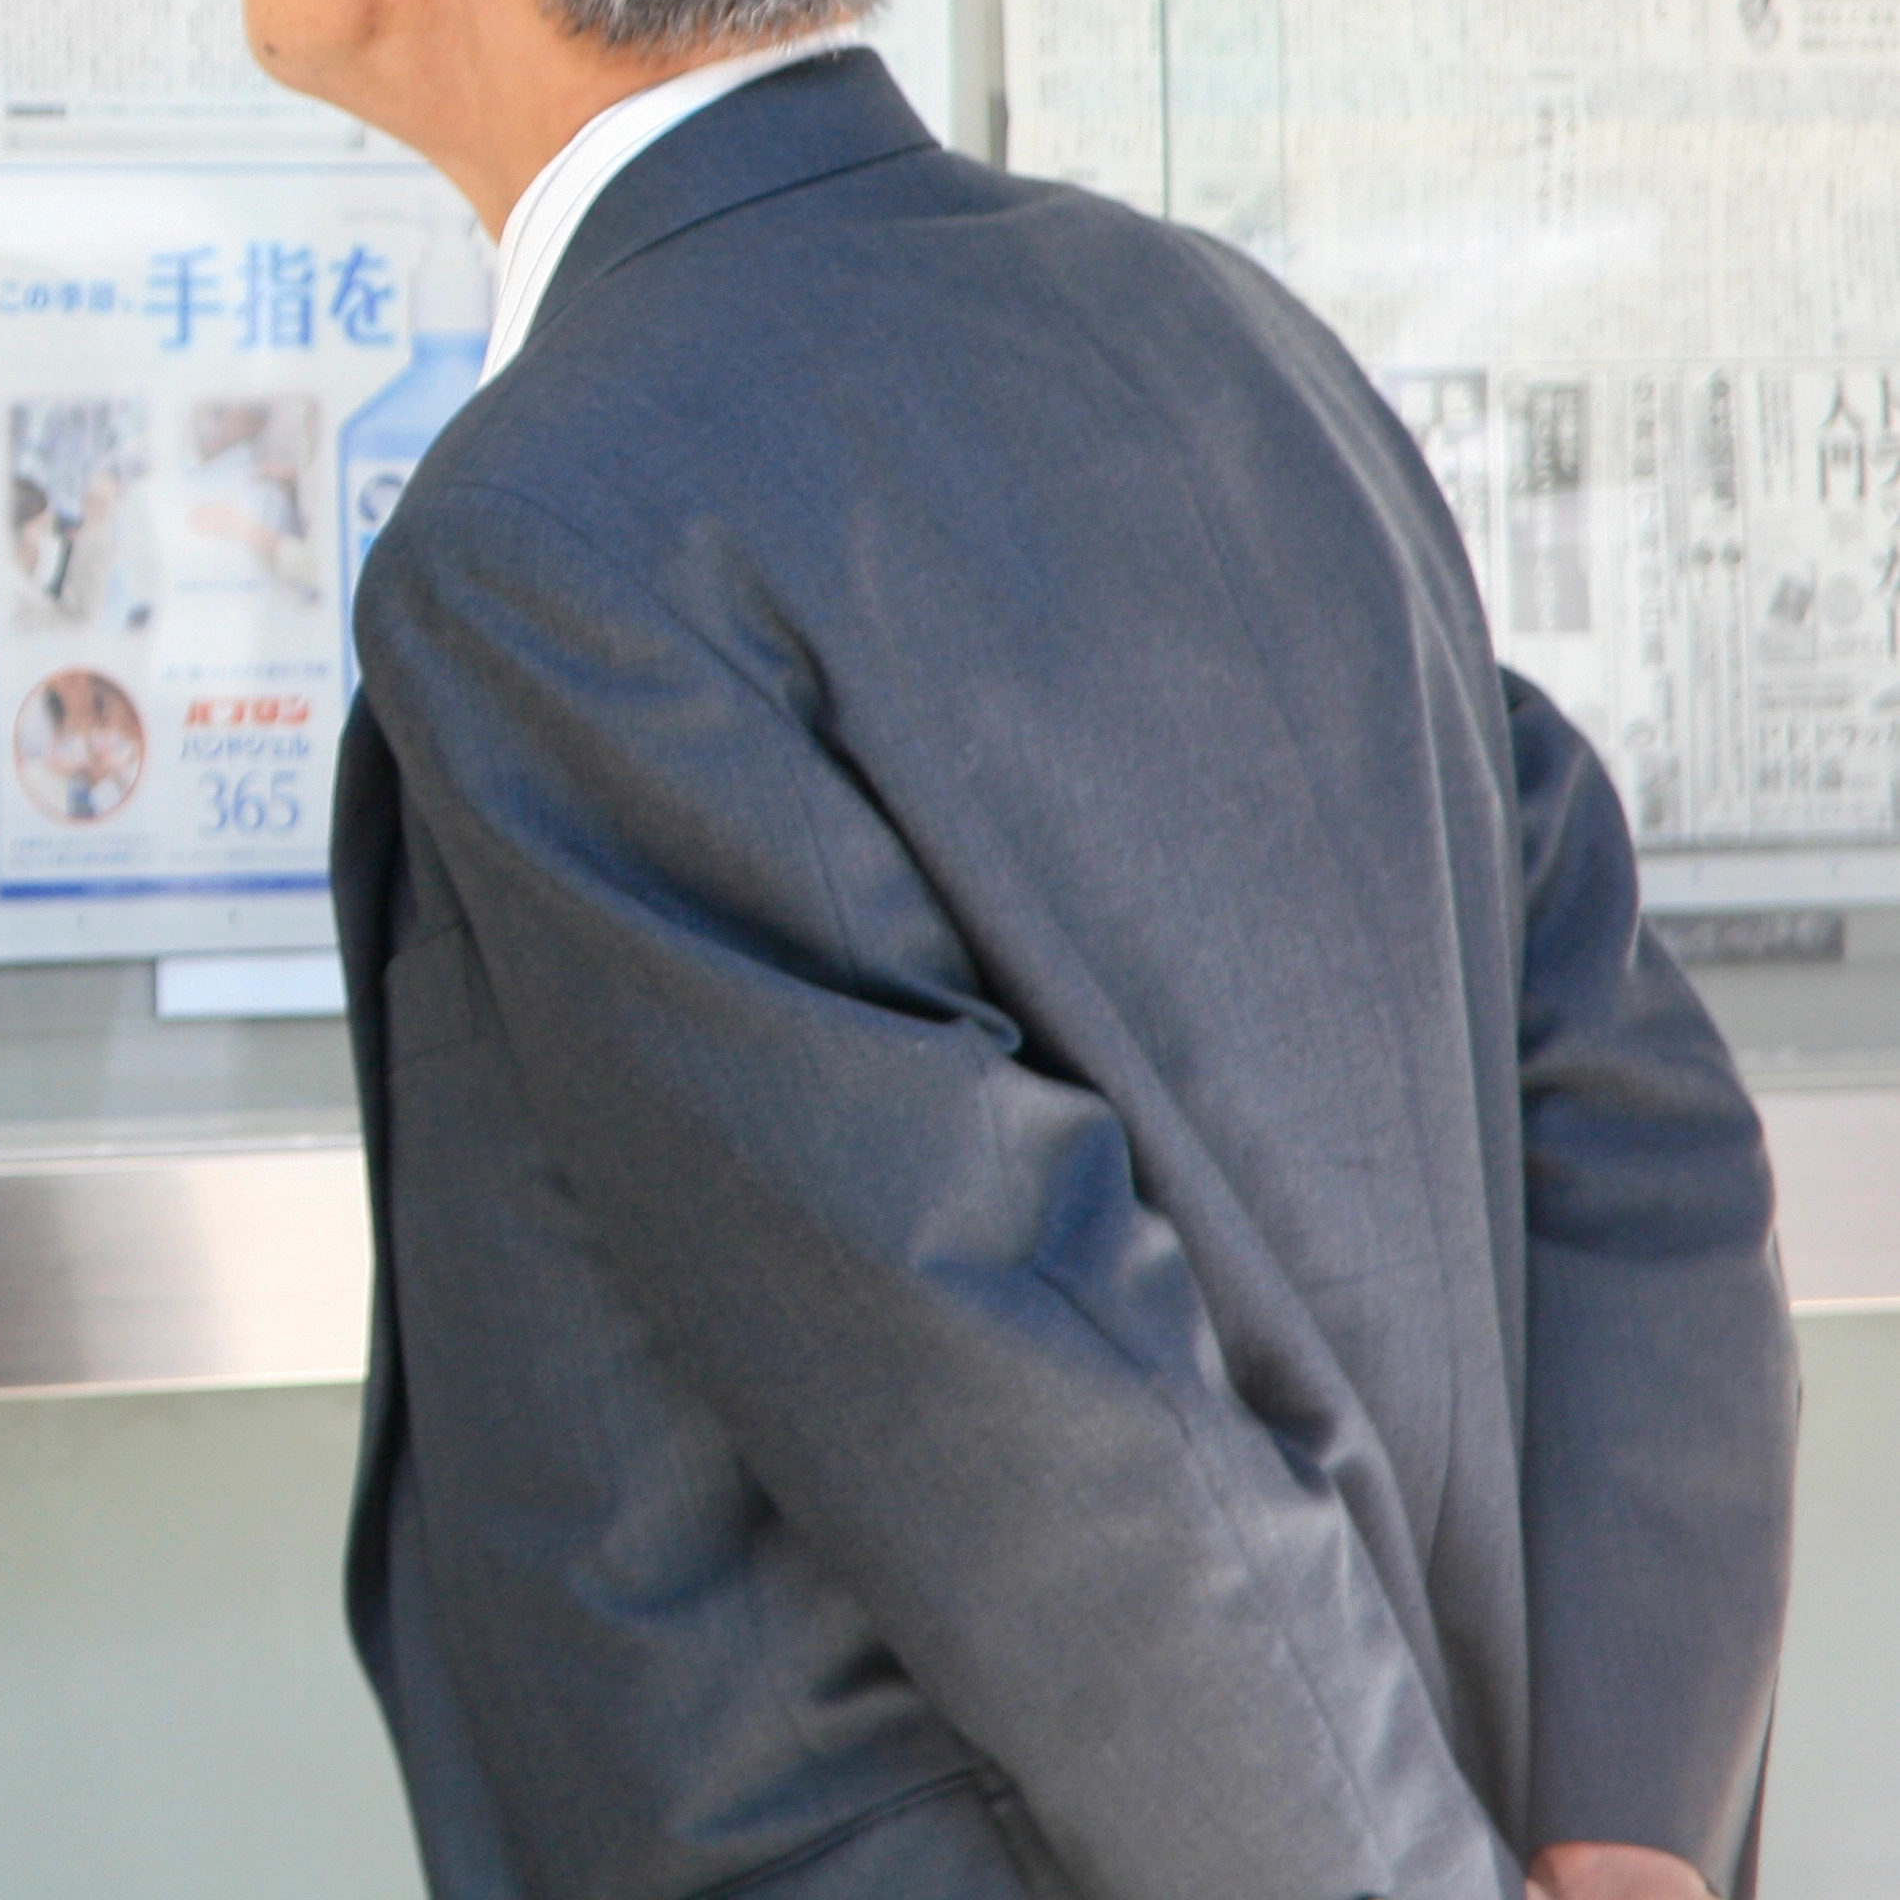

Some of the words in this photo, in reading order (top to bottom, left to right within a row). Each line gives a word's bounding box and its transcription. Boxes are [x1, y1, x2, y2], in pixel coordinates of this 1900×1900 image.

[142, 238, 398, 353] 手指を
[198, 768, 302, 836] 365
